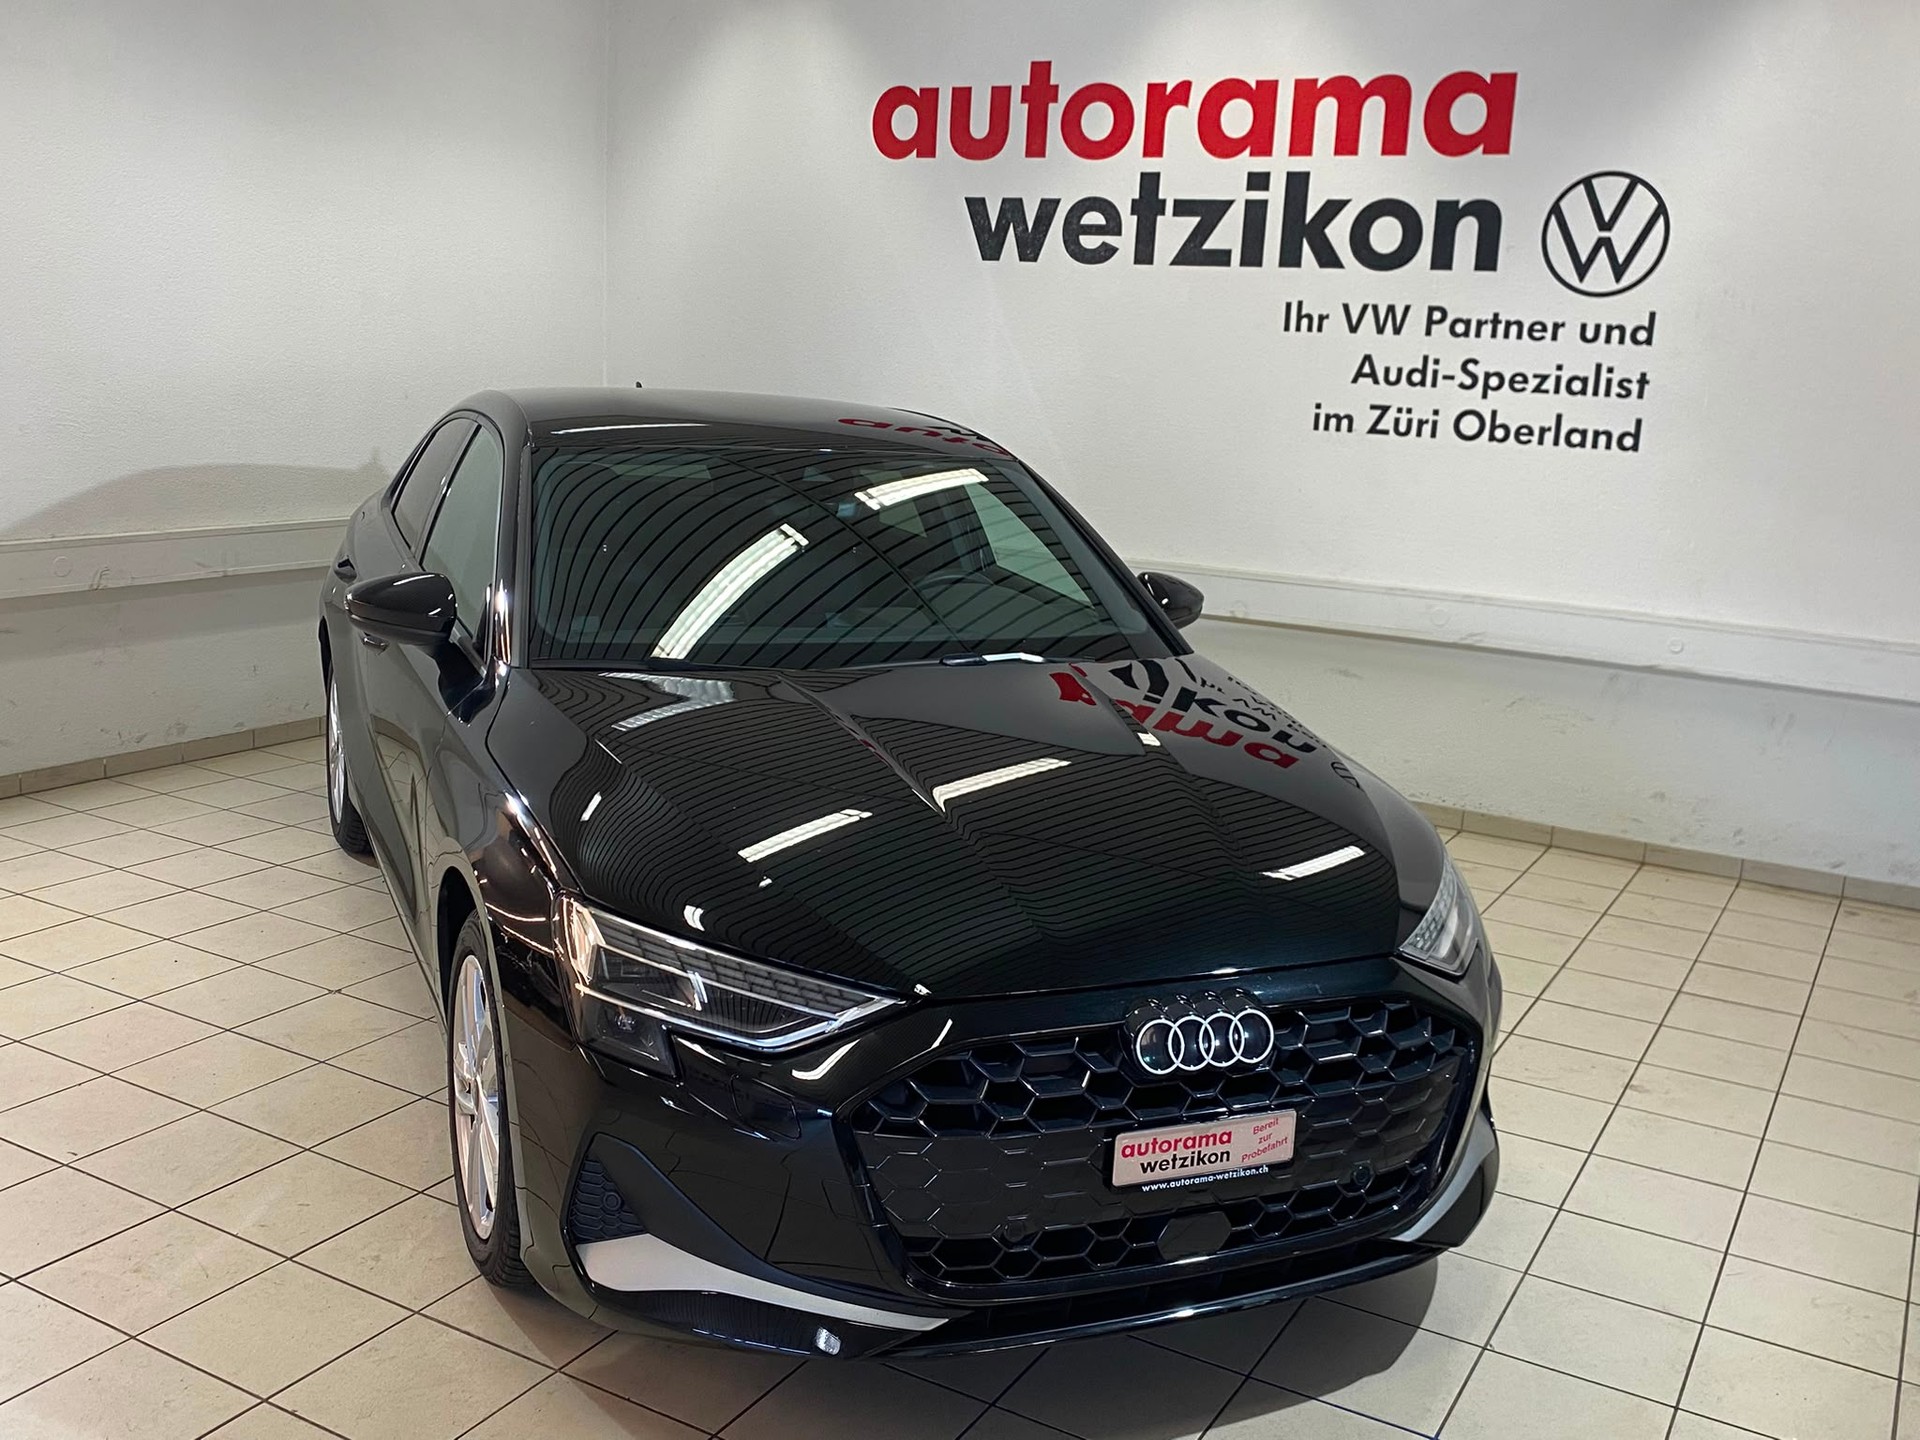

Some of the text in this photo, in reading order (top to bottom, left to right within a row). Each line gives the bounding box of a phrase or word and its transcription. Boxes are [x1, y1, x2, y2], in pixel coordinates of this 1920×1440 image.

[872, 60, 1518, 161] autorama
[965, 171, 1503, 273] wetzikon
[1283, 300, 1657, 347] Ihr VW Partner und
[1350, 353, 1651, 400] Audi-Spezialist
[1312, 402, 1643, 453] im Züri Oberland
[1252, 1117, 1279, 1135] Bereit
[1258, 1131, 1273, 1144] zur
[1121, 1130, 1232, 1159] autorama
[1241, 1136, 1288, 1163] Probefahrt
[1140, 1150, 1231, 1174] wetzikon
[1141, 1164, 1269, 1192] www.autorama-wetzikon.ch
